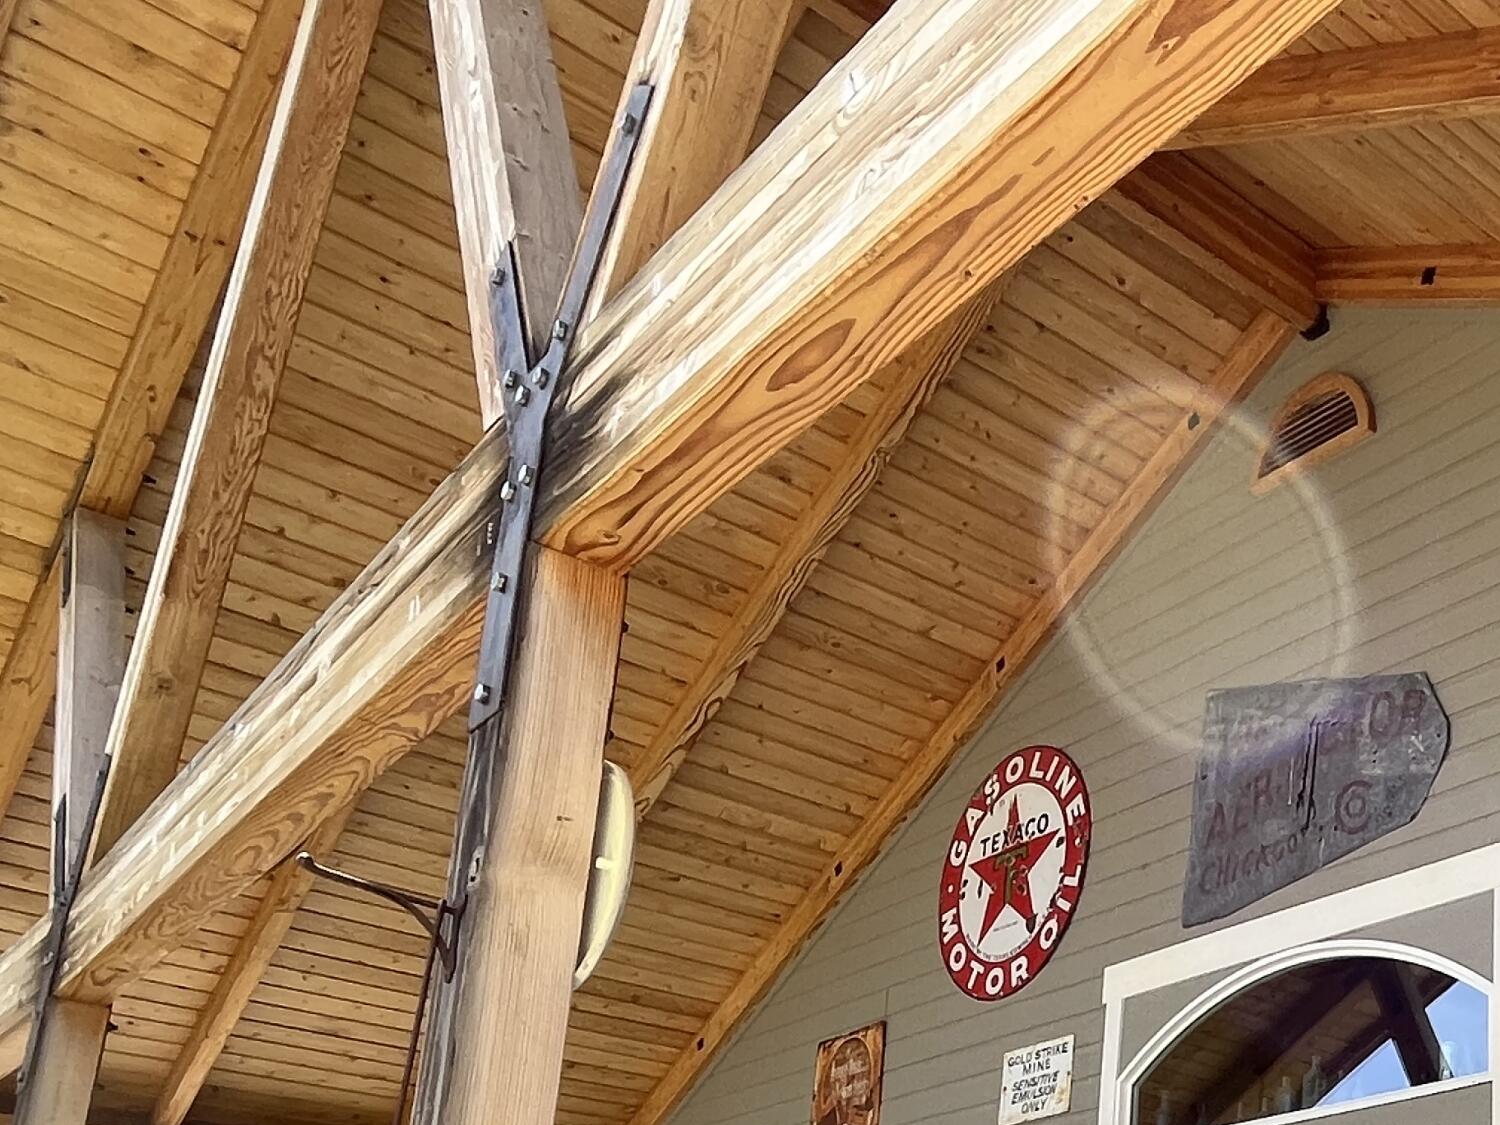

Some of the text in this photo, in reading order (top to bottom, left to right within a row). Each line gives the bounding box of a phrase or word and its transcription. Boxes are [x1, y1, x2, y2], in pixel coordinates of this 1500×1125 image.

[950, 750, 1086, 867] GASOLINE
[980, 812, 1050, 857] TEXACO
[1039, 864, 1082, 950] OIL
[941, 906, 1030, 996] MOTOR
[1008, 1041, 1069, 1067] GOLD STRIKE
[1023, 1058, 1051, 1077] MINE
[1012, 1070, 1060, 1092] SENSITIVE
[1021, 1097, 1048, 1114] ONLY
